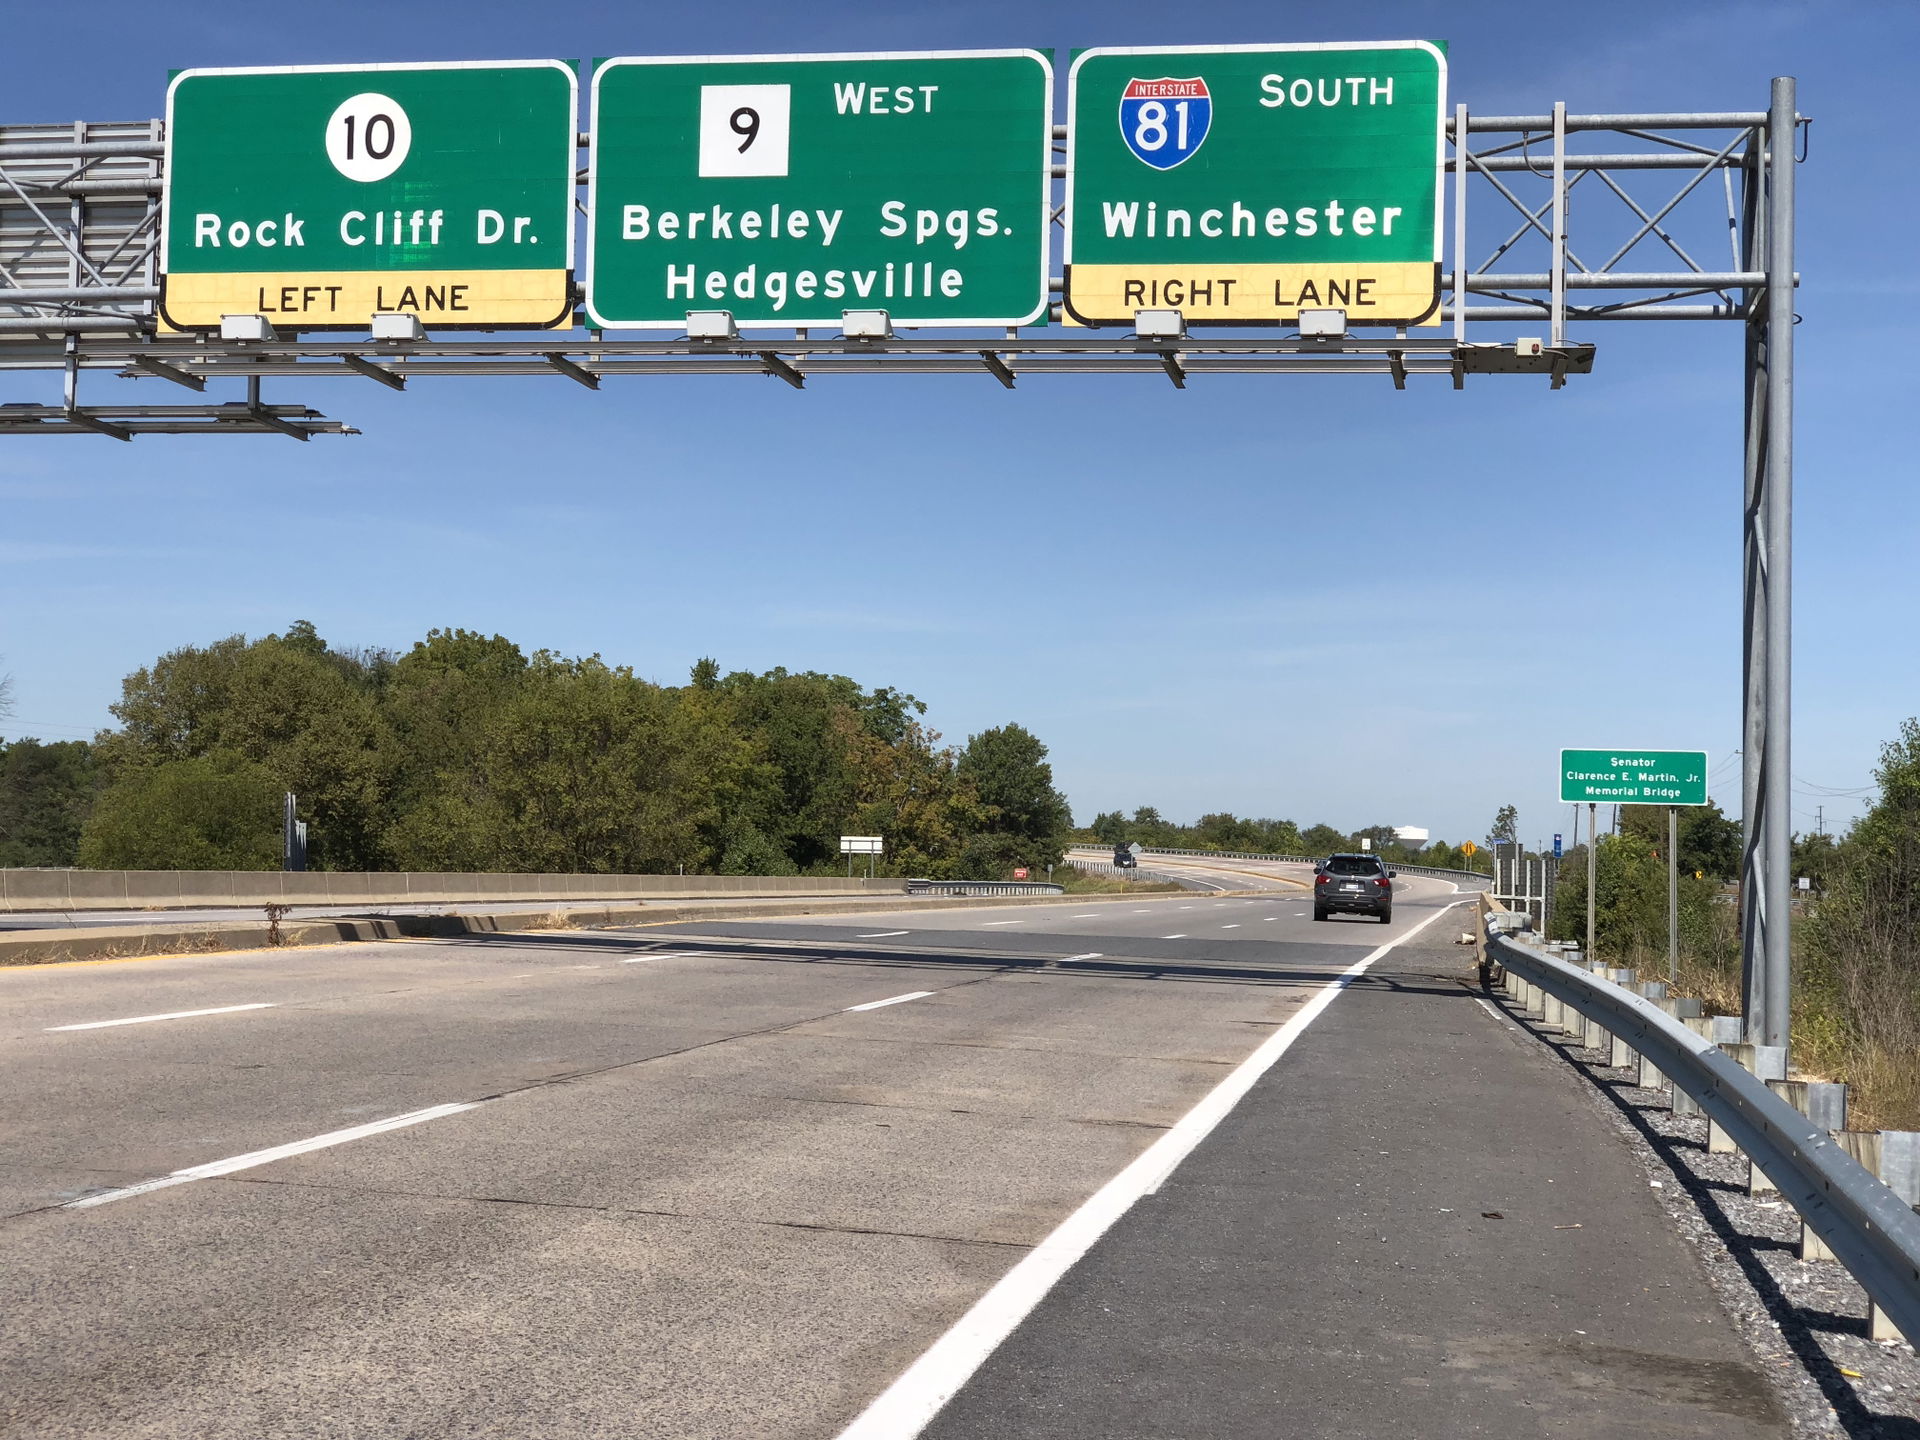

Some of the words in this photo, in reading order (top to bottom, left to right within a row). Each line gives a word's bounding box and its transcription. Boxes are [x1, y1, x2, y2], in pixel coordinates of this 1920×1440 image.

[834, 82, 939, 114] WEST
[1134, 83, 1198, 96] INTERSTATE
[1260, 74, 1394, 107] SOUTH
[343, 113, 396, 161] 10
[730, 107, 760, 154] 9
[1135, 101, 1189, 151] 81
[195, 213, 305, 247] Rock
[341, 210, 443, 246] Cliff
[477, 209, 538, 244] Dr.
[622, 204, 842, 246] Berkeley
[880, 201, 1012, 250] Spgs.
[1103, 200, 1402, 237] Winchester
[259, 287, 343, 312] LEFT
[377, 285, 468, 311] LANE
[666, 262, 963, 311] Hedgesville
[1125, 280, 1236, 306] RIGHT
[1275, 279, 1376, 306] LANE
[1566, 771, 1616, 781] Clarence
[1622, 772, 1632, 781] E.
[1686, 774, 1701, 783] Jr.
[1611, 757, 1656, 767] Senator
[1585, 786, 1638, 796] Memorial
[1644, 787, 1681, 799] Bridge
